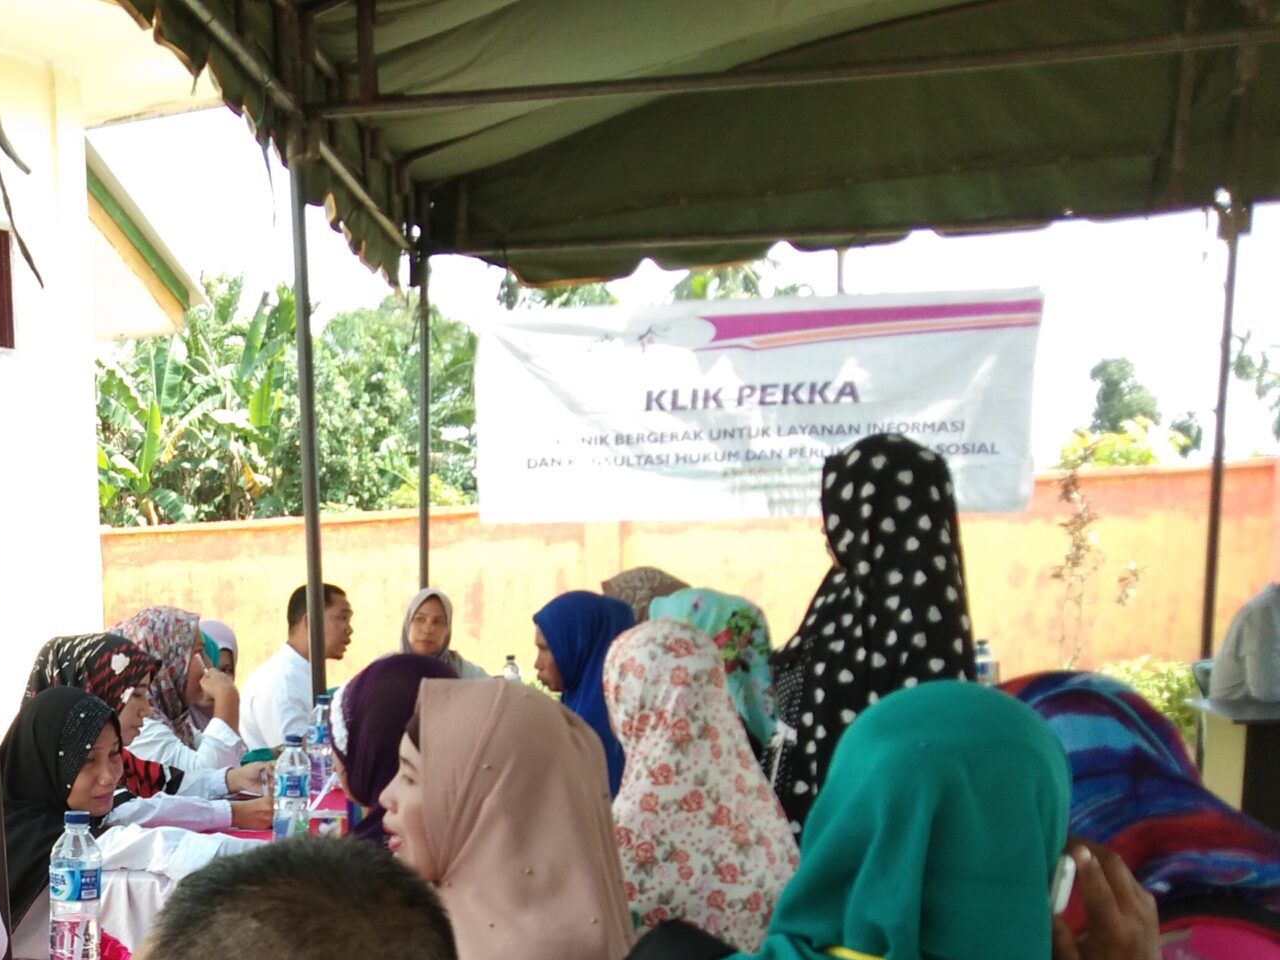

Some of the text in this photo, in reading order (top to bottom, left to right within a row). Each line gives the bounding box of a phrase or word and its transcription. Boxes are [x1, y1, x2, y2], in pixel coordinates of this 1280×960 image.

[644, 380, 861, 412] KLIK PEKKA
[614, 429, 705, 447] BERGERAK
[708, 425, 771, 442] UNTUK
[777, 422, 861, 438] LAYANAN
[866, 419, 966, 436] INFORMASI
[674, 449, 740, 466] HUKUM
[745, 447, 783, 462] DAN
[936, 440, 1000, 457] SOSIAL
